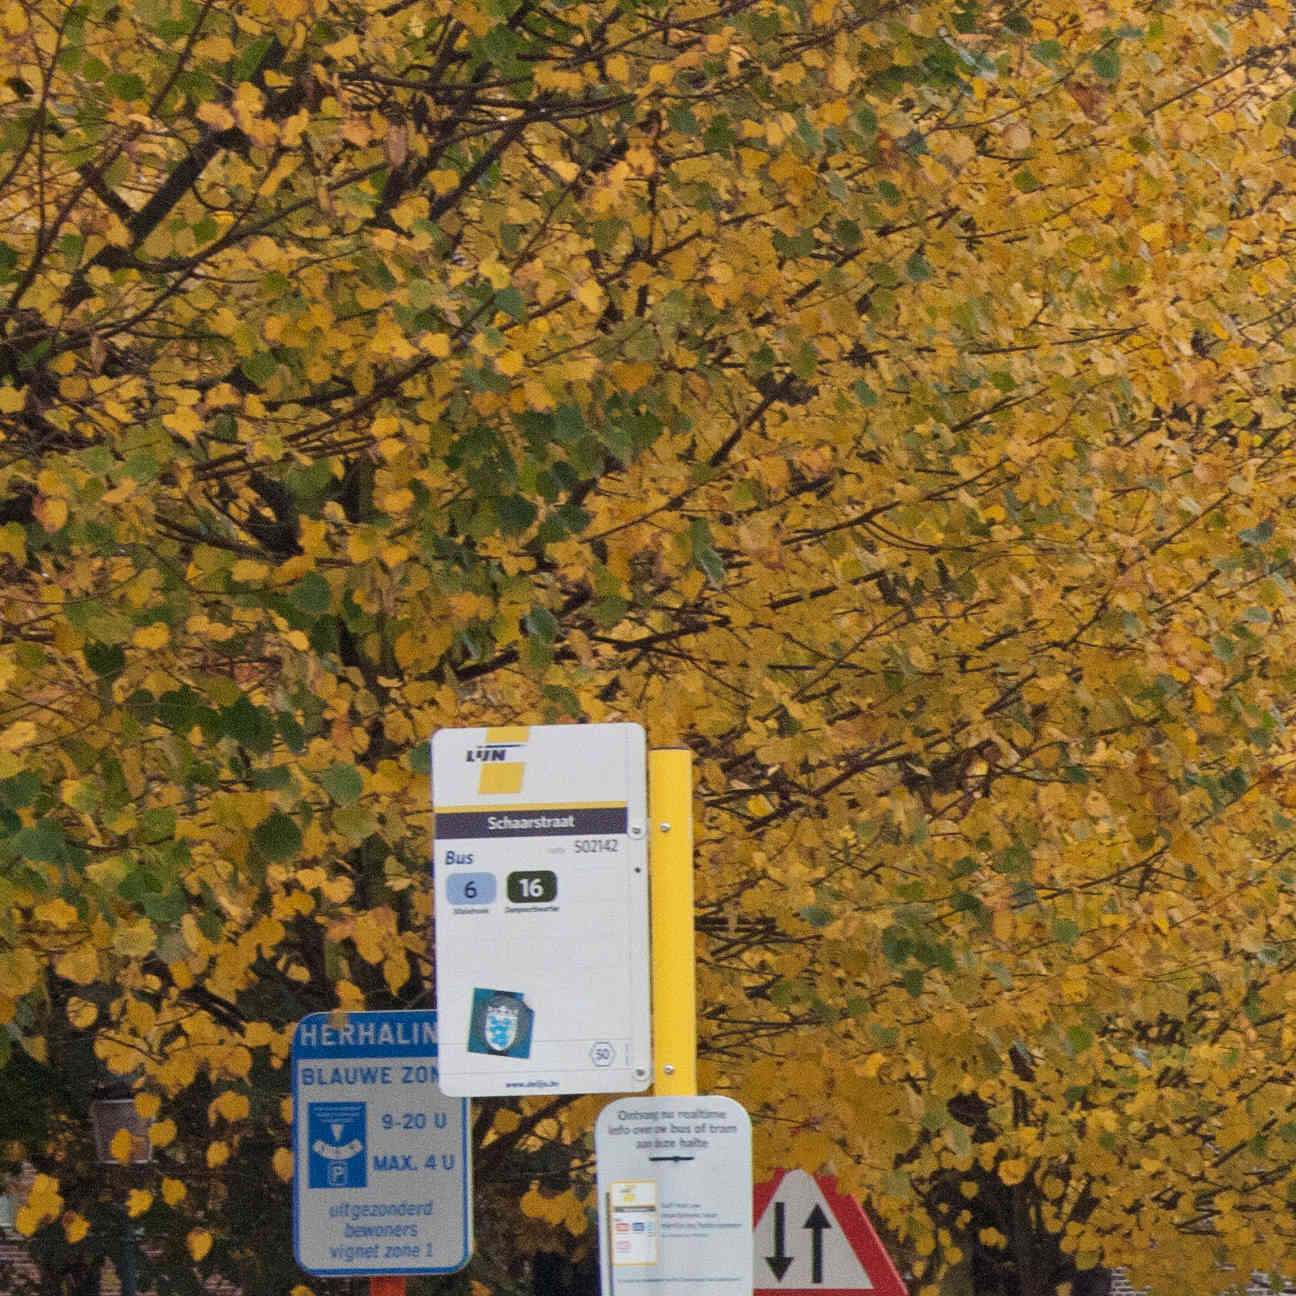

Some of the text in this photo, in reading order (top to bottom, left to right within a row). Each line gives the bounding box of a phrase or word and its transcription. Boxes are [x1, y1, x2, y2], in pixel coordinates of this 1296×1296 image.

[487, 815, 577, 830] Schaarstraat
[574, 839, 618, 854] 502142
[445, 850, 475, 865] Bus
[464, 881, 477, 898] 6
[519, 878, 544, 897] 16
[301, 1021, 439, 1047] HERHALIN
[301, 1066, 439, 1086] BLAUWE ZON
[382, 1113, 426, 1130] 9-20
[434, 1112, 447, 1129] U
[670, 1124, 691, 1134] bus
[373, 1154, 455, 1171] MAX. 4 U
[329, 1200, 434, 1220] uitgezonderd
[344, 1223, 418, 1238] bewoners
[329, 1242, 432, 1263] vignet zone 1
